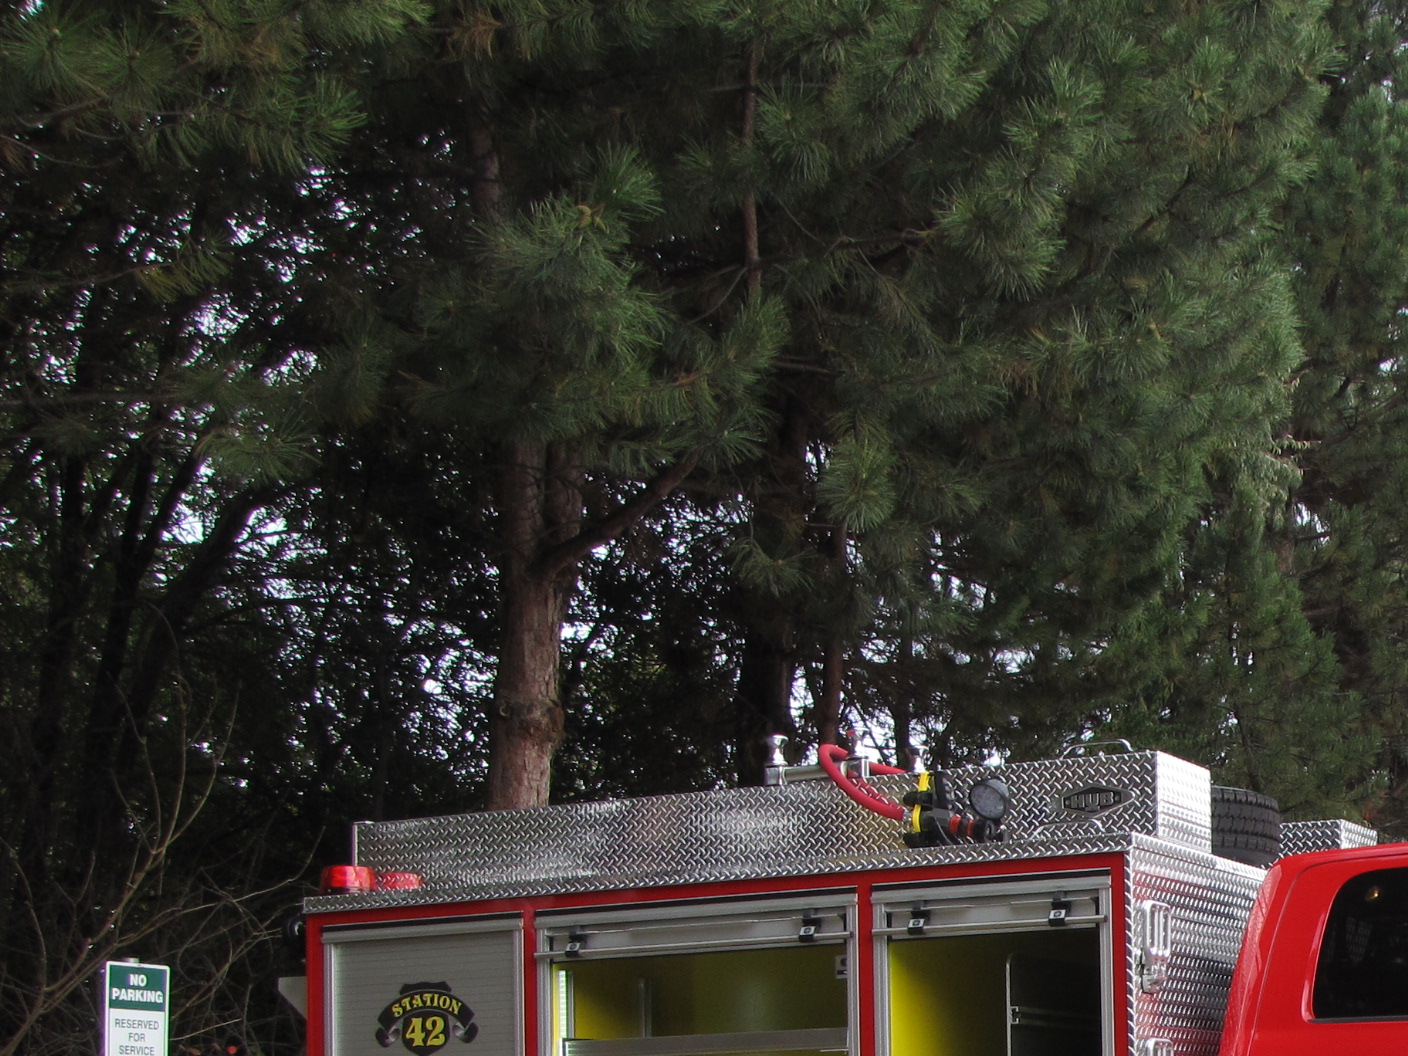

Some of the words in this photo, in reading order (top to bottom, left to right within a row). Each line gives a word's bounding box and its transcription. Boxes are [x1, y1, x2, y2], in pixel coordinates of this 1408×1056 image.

[129, 973, 147, 987] NO
[111, 987, 164, 1003] PARKING
[391, 993, 463, 1018] STATION
[114, 1018, 160, 1030] RESERVED
[128, 1032, 146, 1042] FOR
[405, 1016, 446, 1047] 42
[118, 1045, 155, 1056] SERVICE
